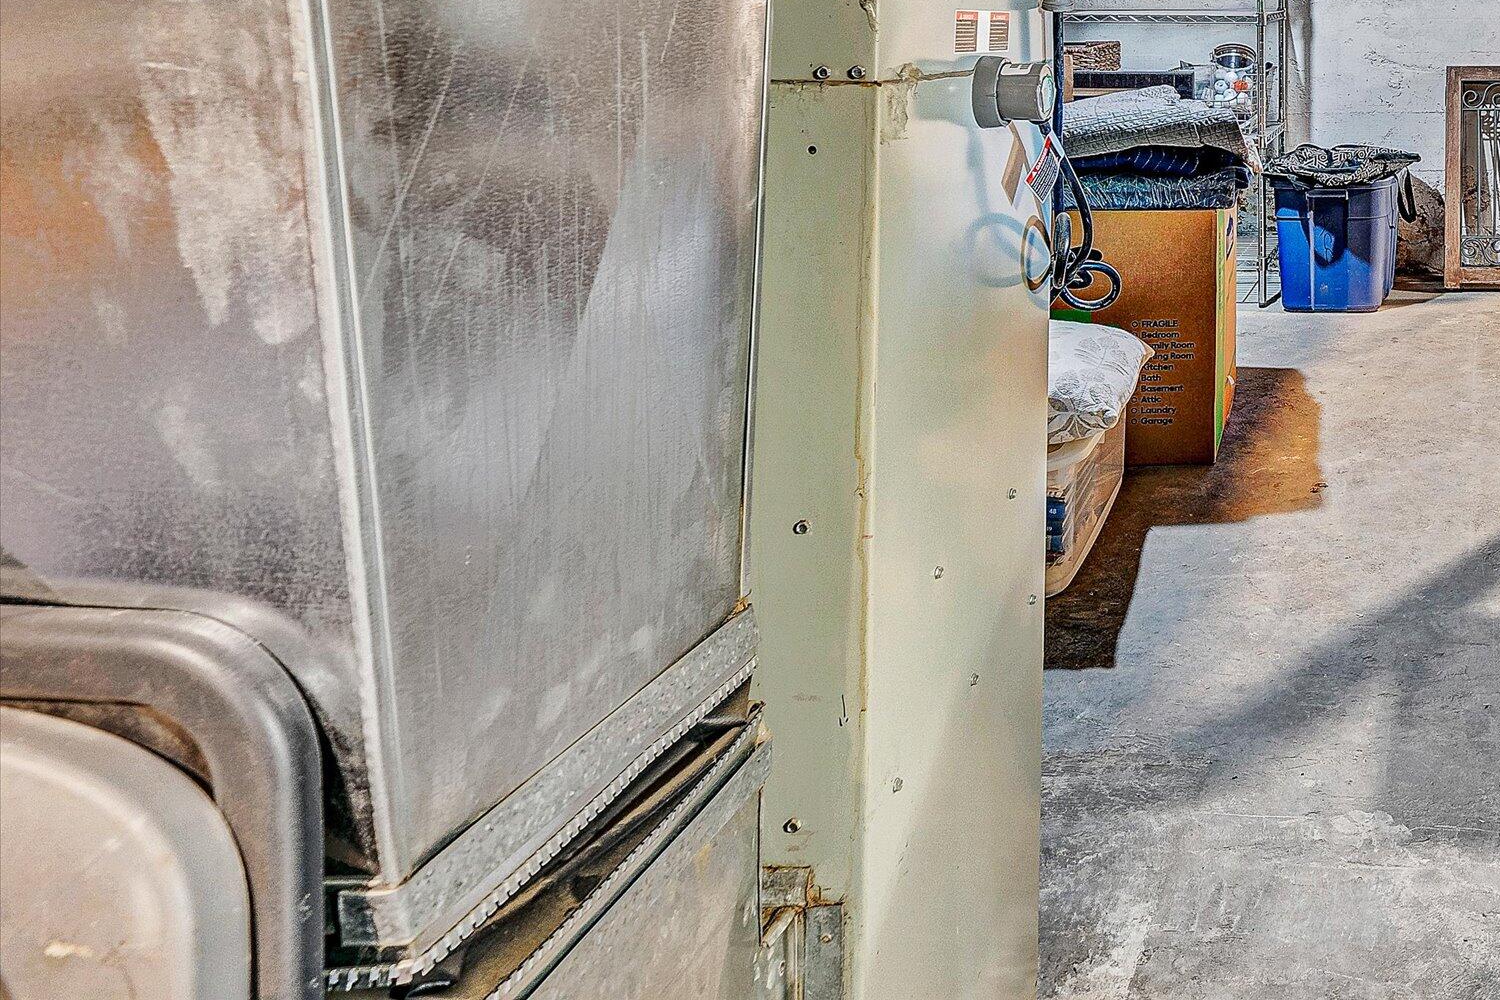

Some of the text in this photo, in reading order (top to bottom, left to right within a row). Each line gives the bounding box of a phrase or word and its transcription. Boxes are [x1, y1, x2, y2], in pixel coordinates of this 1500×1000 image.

[1141, 320, 1179, 328] FRAGILE
[1141, 331, 1180, 339] Bedroom
[1170, 341, 1195, 349] Room
[1170, 352, 1194, 360] Room
[1142, 363, 1174, 371] Kitchen
[1140, 384, 1184, 392] Basement
[1141, 395, 1162, 403] Attic
[1141, 406, 1177, 415] Laundry
[1141, 417, 1173, 425] Garage
